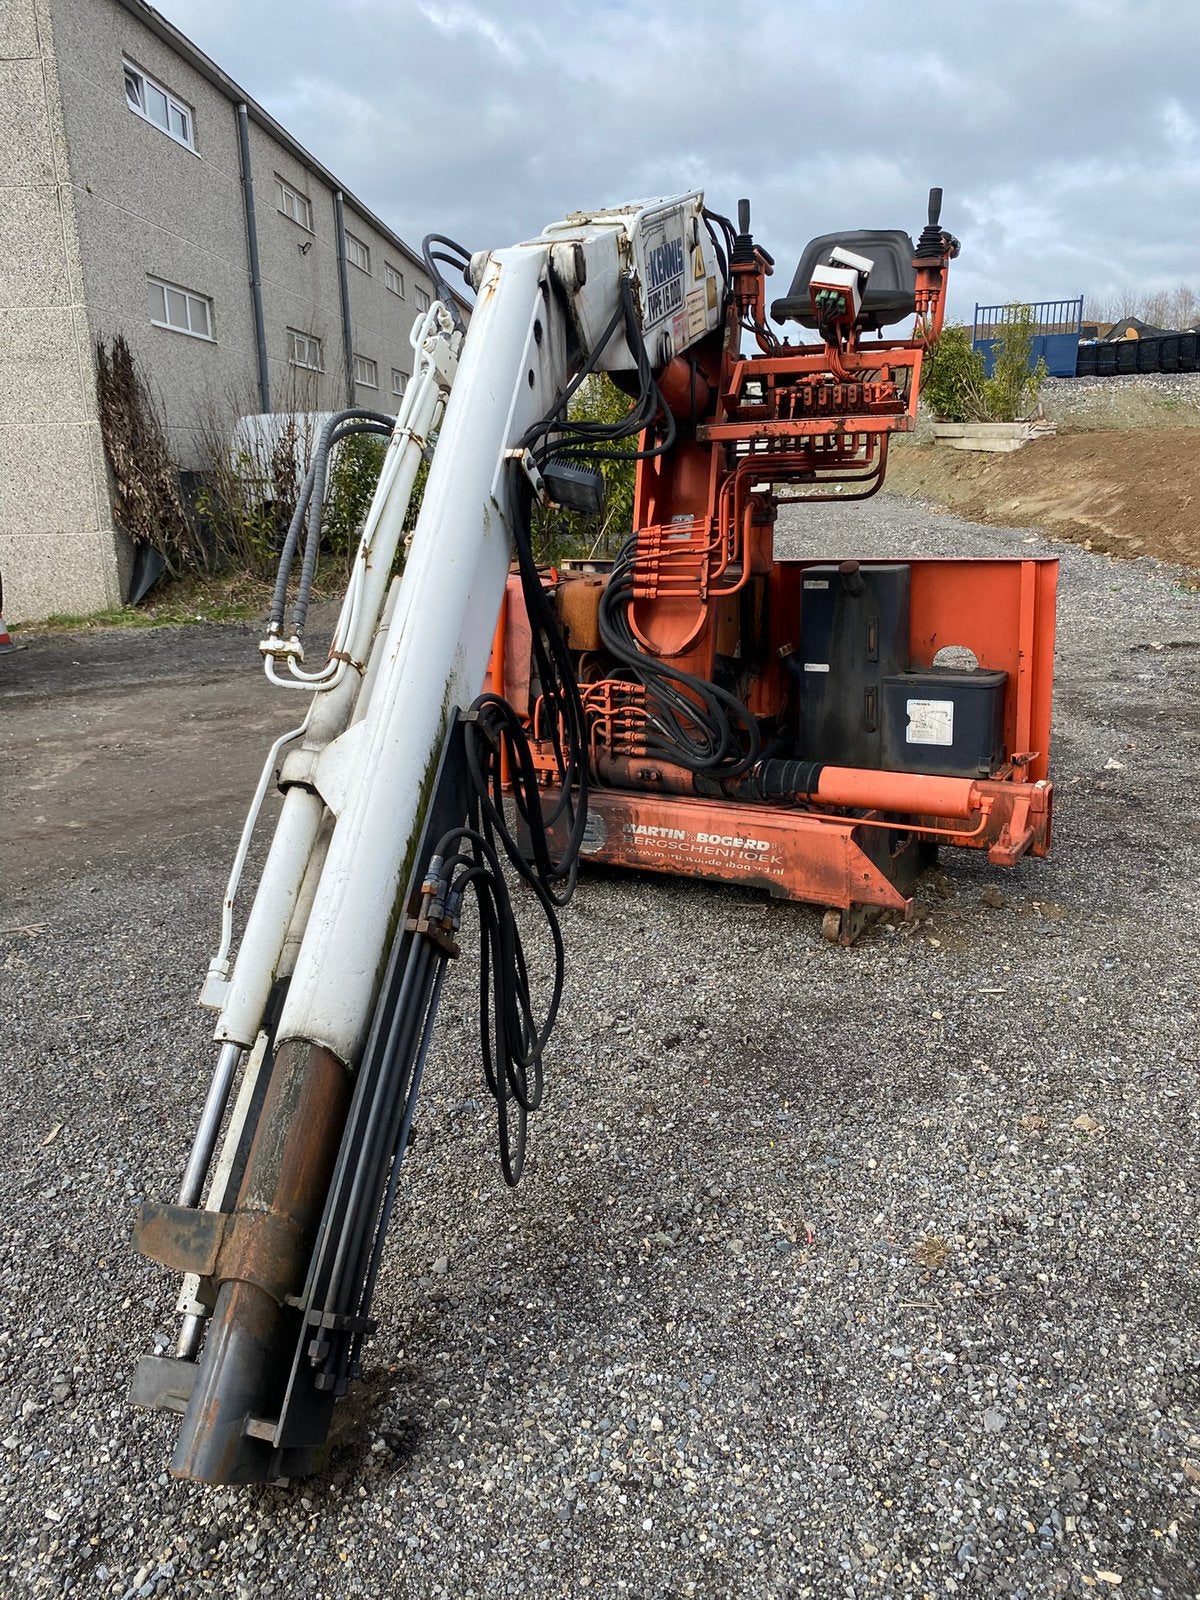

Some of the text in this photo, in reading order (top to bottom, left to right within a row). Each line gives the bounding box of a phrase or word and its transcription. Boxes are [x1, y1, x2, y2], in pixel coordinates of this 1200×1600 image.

[649, 236, 684, 288] KENNIS
[648, 291, 662, 322] TYPE
[623, 822, 686, 840] MARTIN
[696, 832, 770, 852] BOGERD
[623, 834, 784, 865] BERGSCHENHOEK
